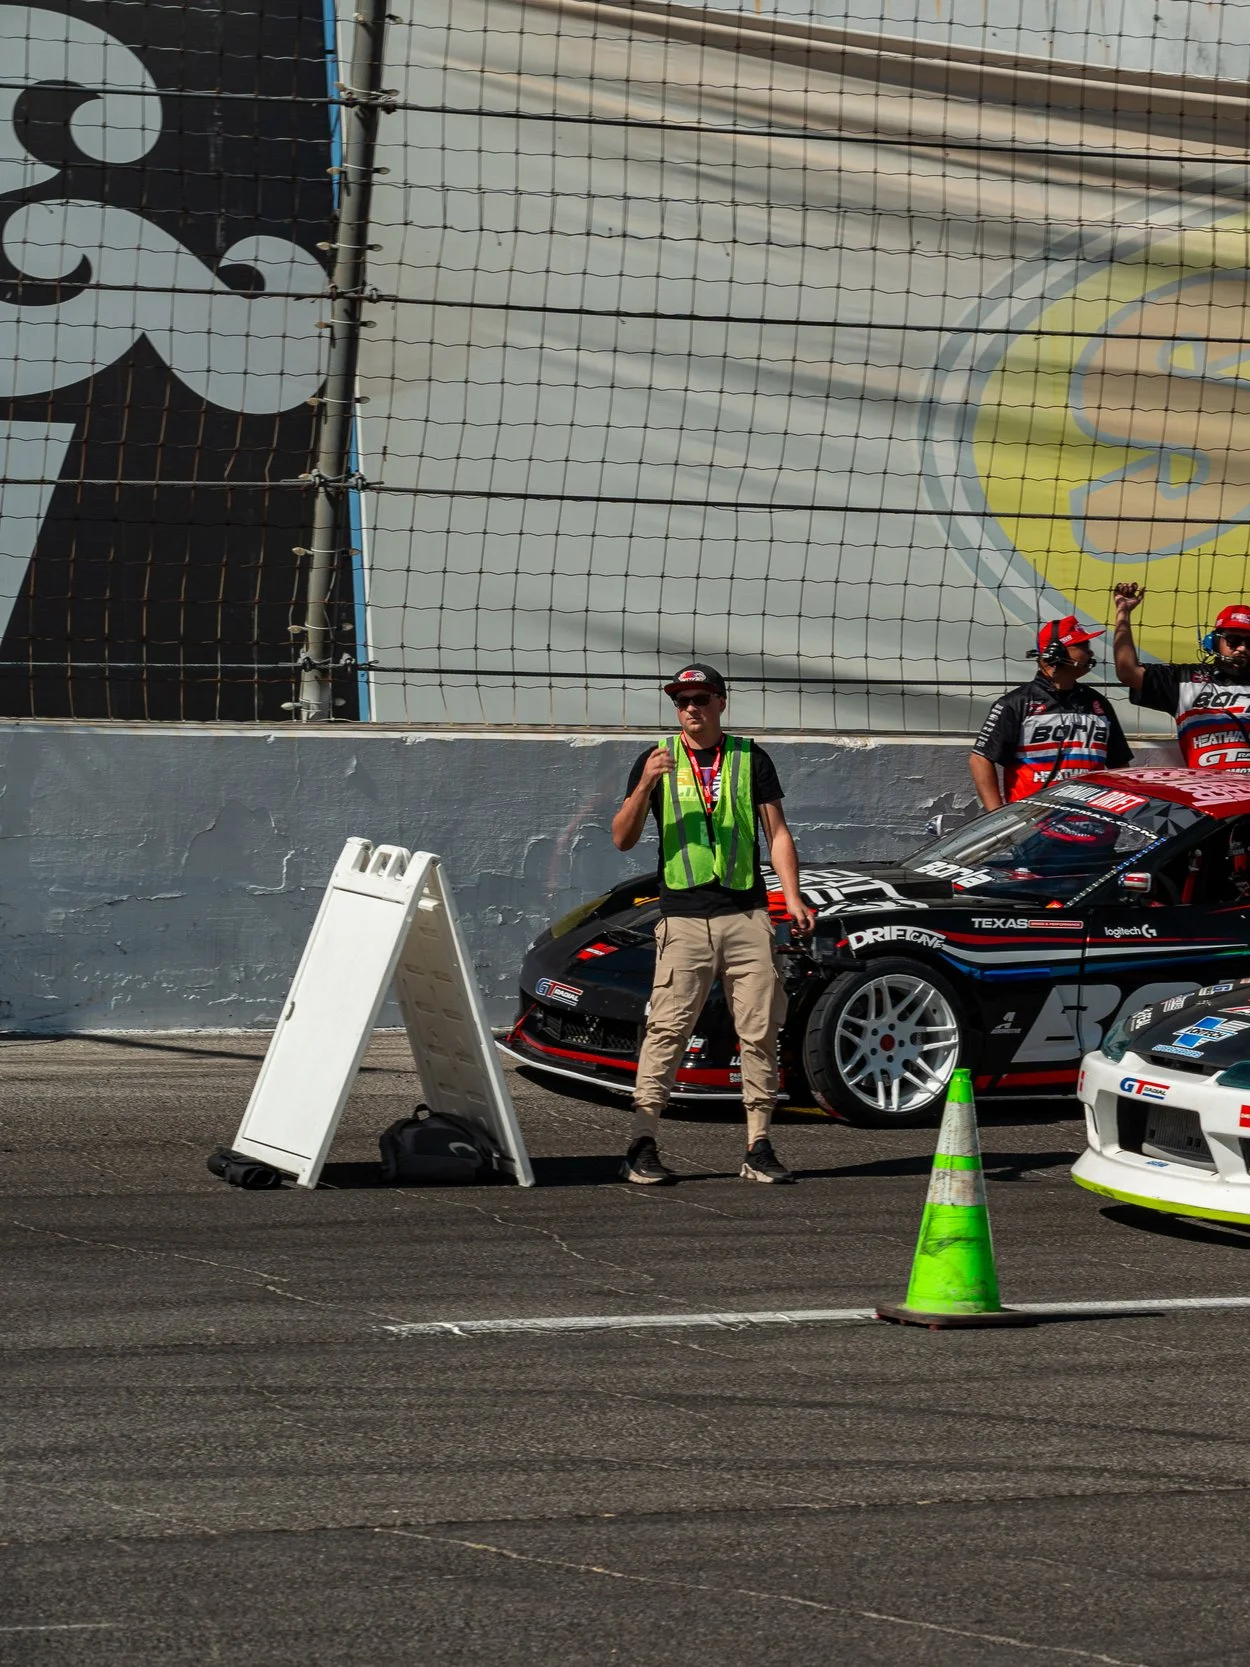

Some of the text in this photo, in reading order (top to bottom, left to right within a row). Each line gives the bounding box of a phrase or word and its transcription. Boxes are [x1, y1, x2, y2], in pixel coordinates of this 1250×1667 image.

[1049, 784, 1107, 803] FORMULA
[1088, 790, 1146, 812] DRIFT
[971, 918, 1028, 929] TEXAS
[1104, 926, 1142, 938] logitech
[848, 925, 947, 950] DRIFT
[536, 978, 584, 1001] GT RADIAL
[1120, 1077, 1170, 1096] GT RADIAL
